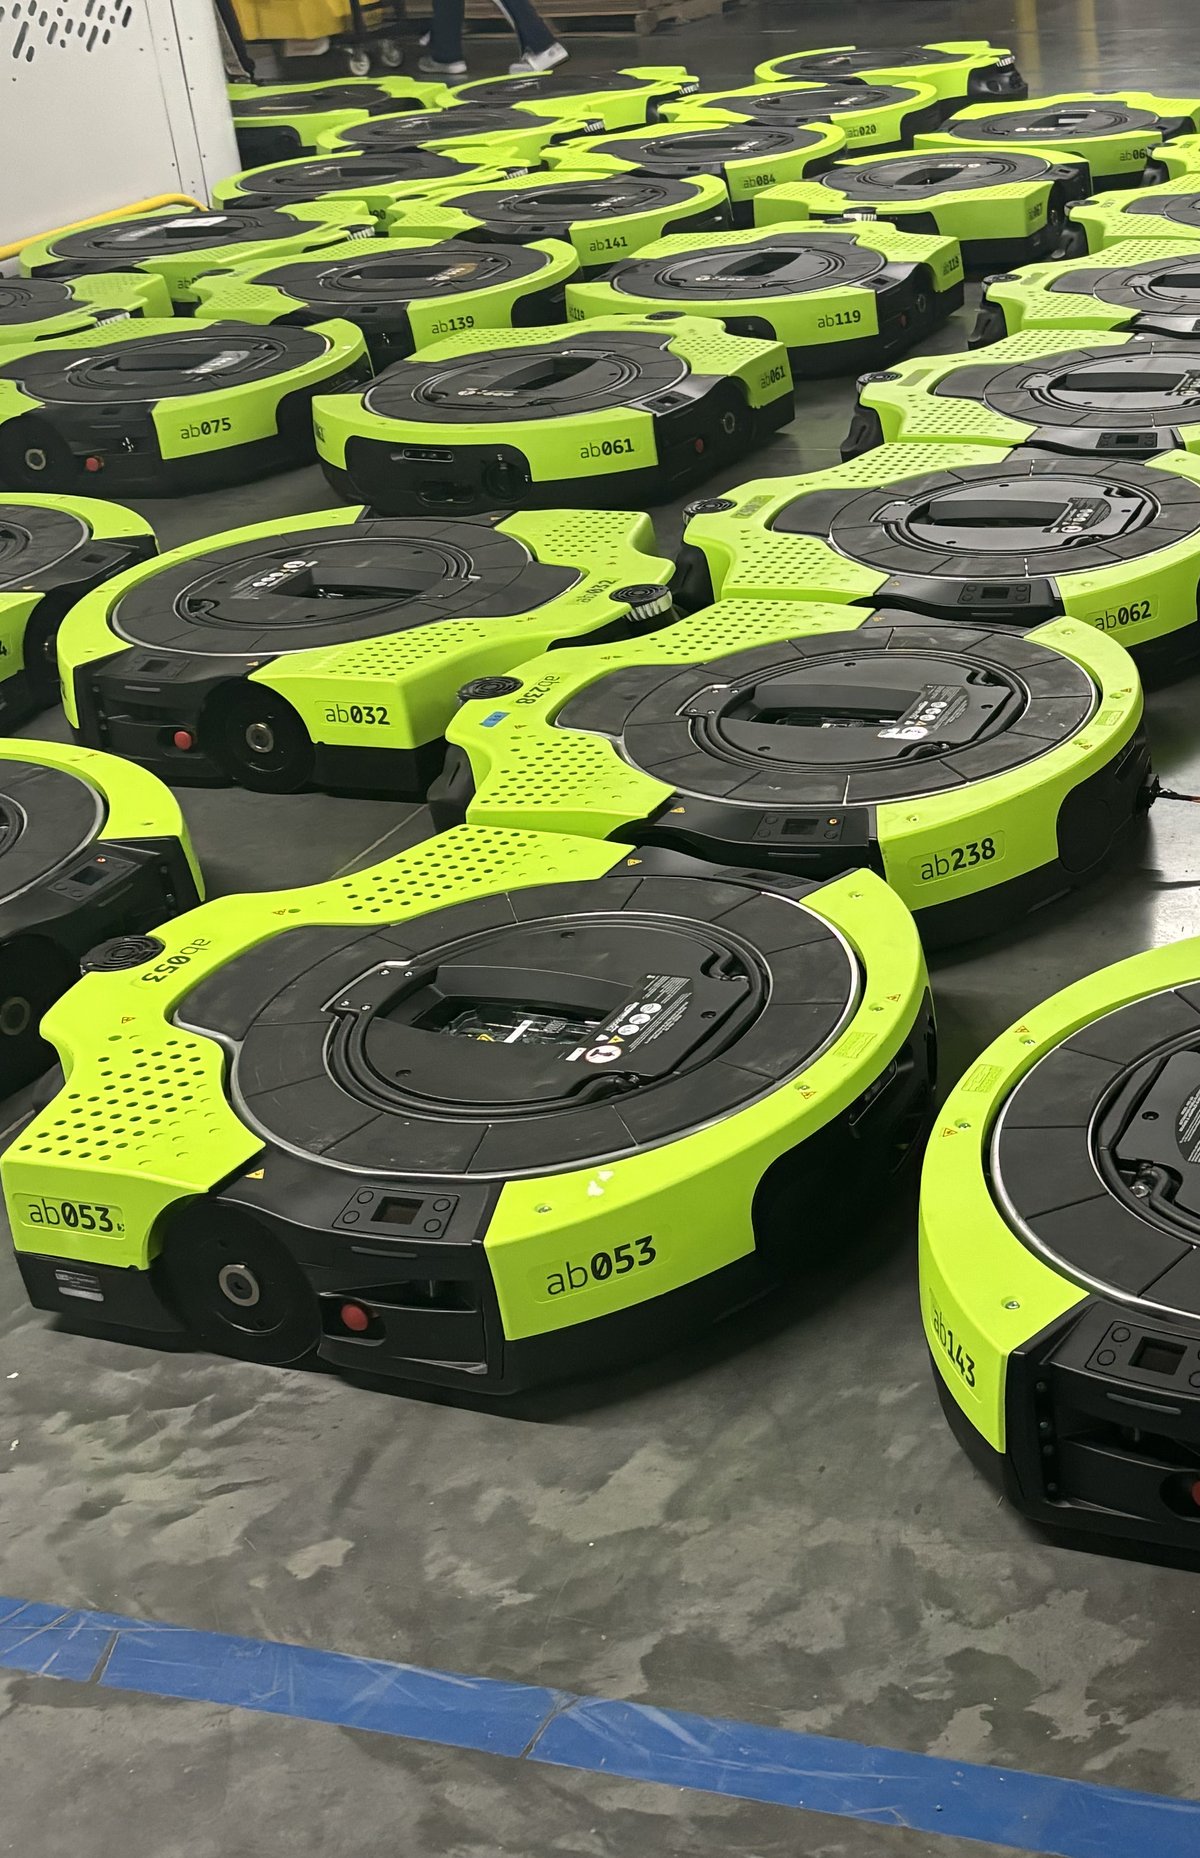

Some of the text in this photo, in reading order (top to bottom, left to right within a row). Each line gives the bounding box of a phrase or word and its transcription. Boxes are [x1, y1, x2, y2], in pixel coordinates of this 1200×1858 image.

[1119, 149, 1146, 161] ab06
[743, 174, 777, 189] ab084
[589, 236, 629, 252] ab141
[431, 315, 475, 334] ab139
[817, 309, 861, 329] ab119
[760, 365, 786, 389] ab061
[180, 417, 232, 440] ab075
[580, 438, 635, 459] ab061
[1094, 600, 1152, 632] ab062
[515, 675, 561, 704] ab238
[324, 703, 392, 726] ab032
[920, 836, 997, 881] ab238
[141, 937, 212, 983] ab053
[28, 1197, 114, 1233] ab053
[546, 1233, 658, 1297] ab053
[933, 1308, 976, 1388] ab143
